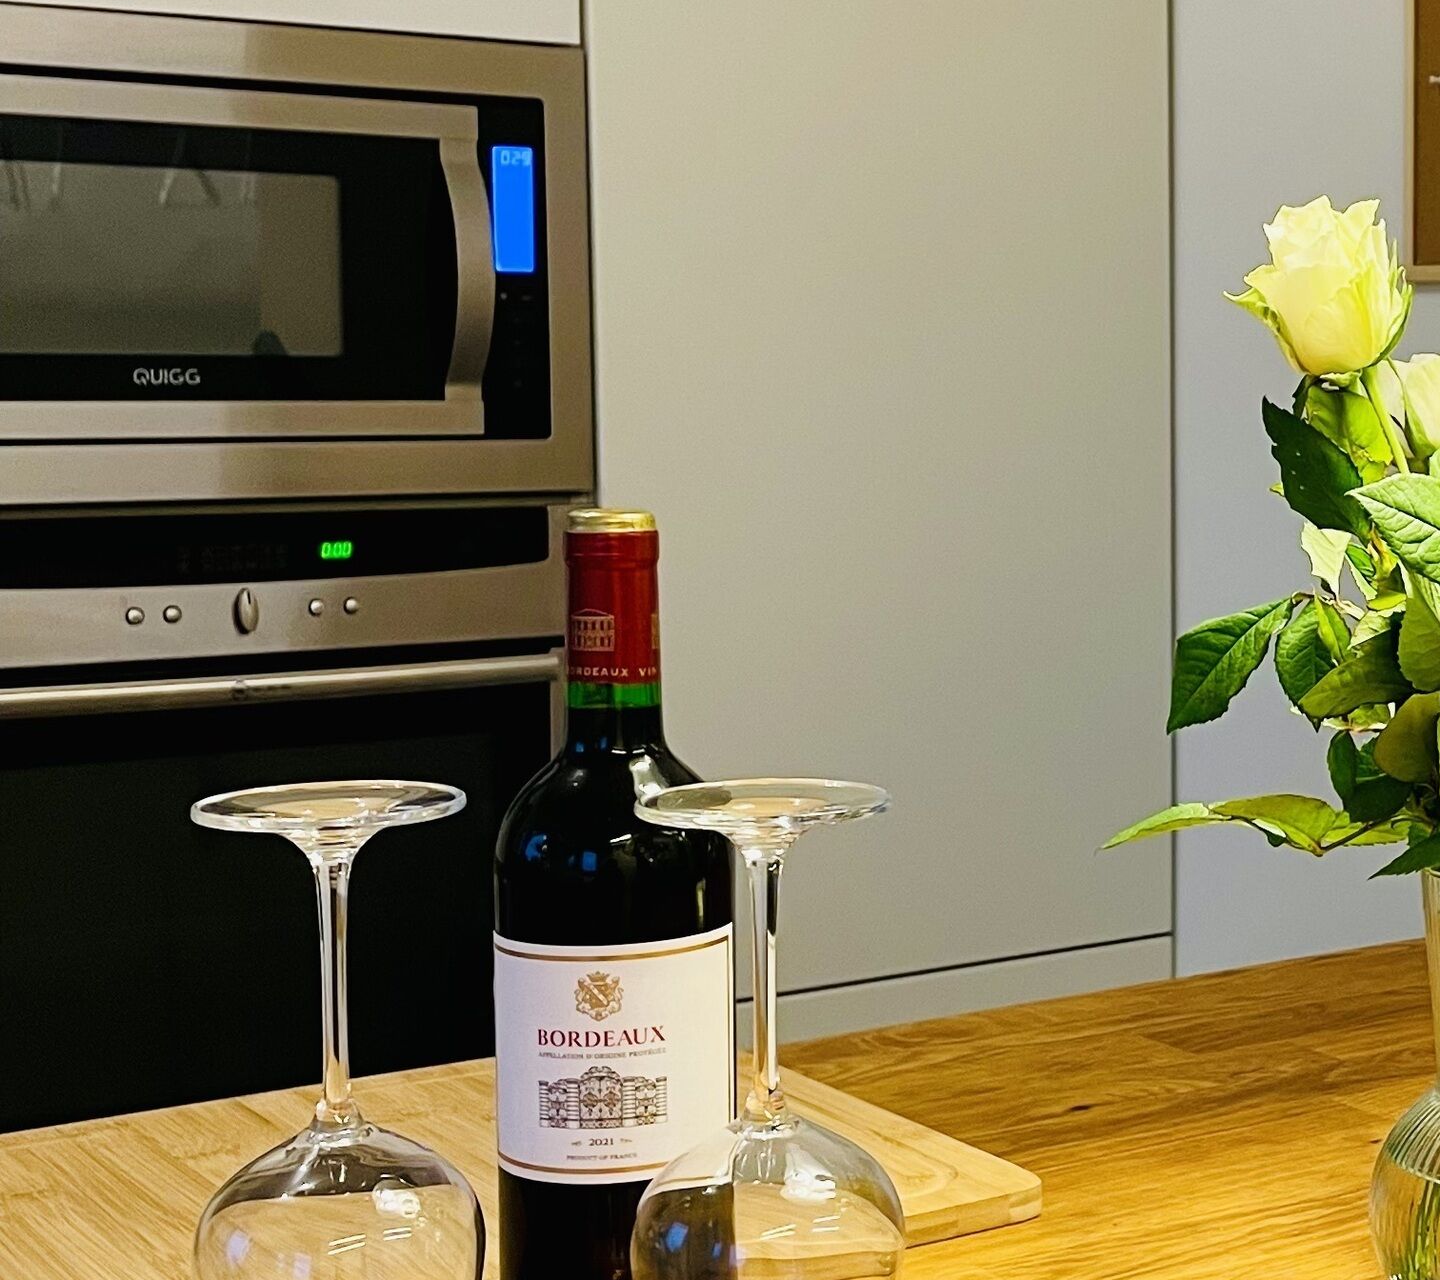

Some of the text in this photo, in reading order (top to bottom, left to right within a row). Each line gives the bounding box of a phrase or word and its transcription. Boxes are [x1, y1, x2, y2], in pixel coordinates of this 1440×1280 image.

[133, 368, 201, 387] QUIGG
[538, 1025, 666, 1048] BORDEAUX
[589, 1138, 614, 1147] 2021
